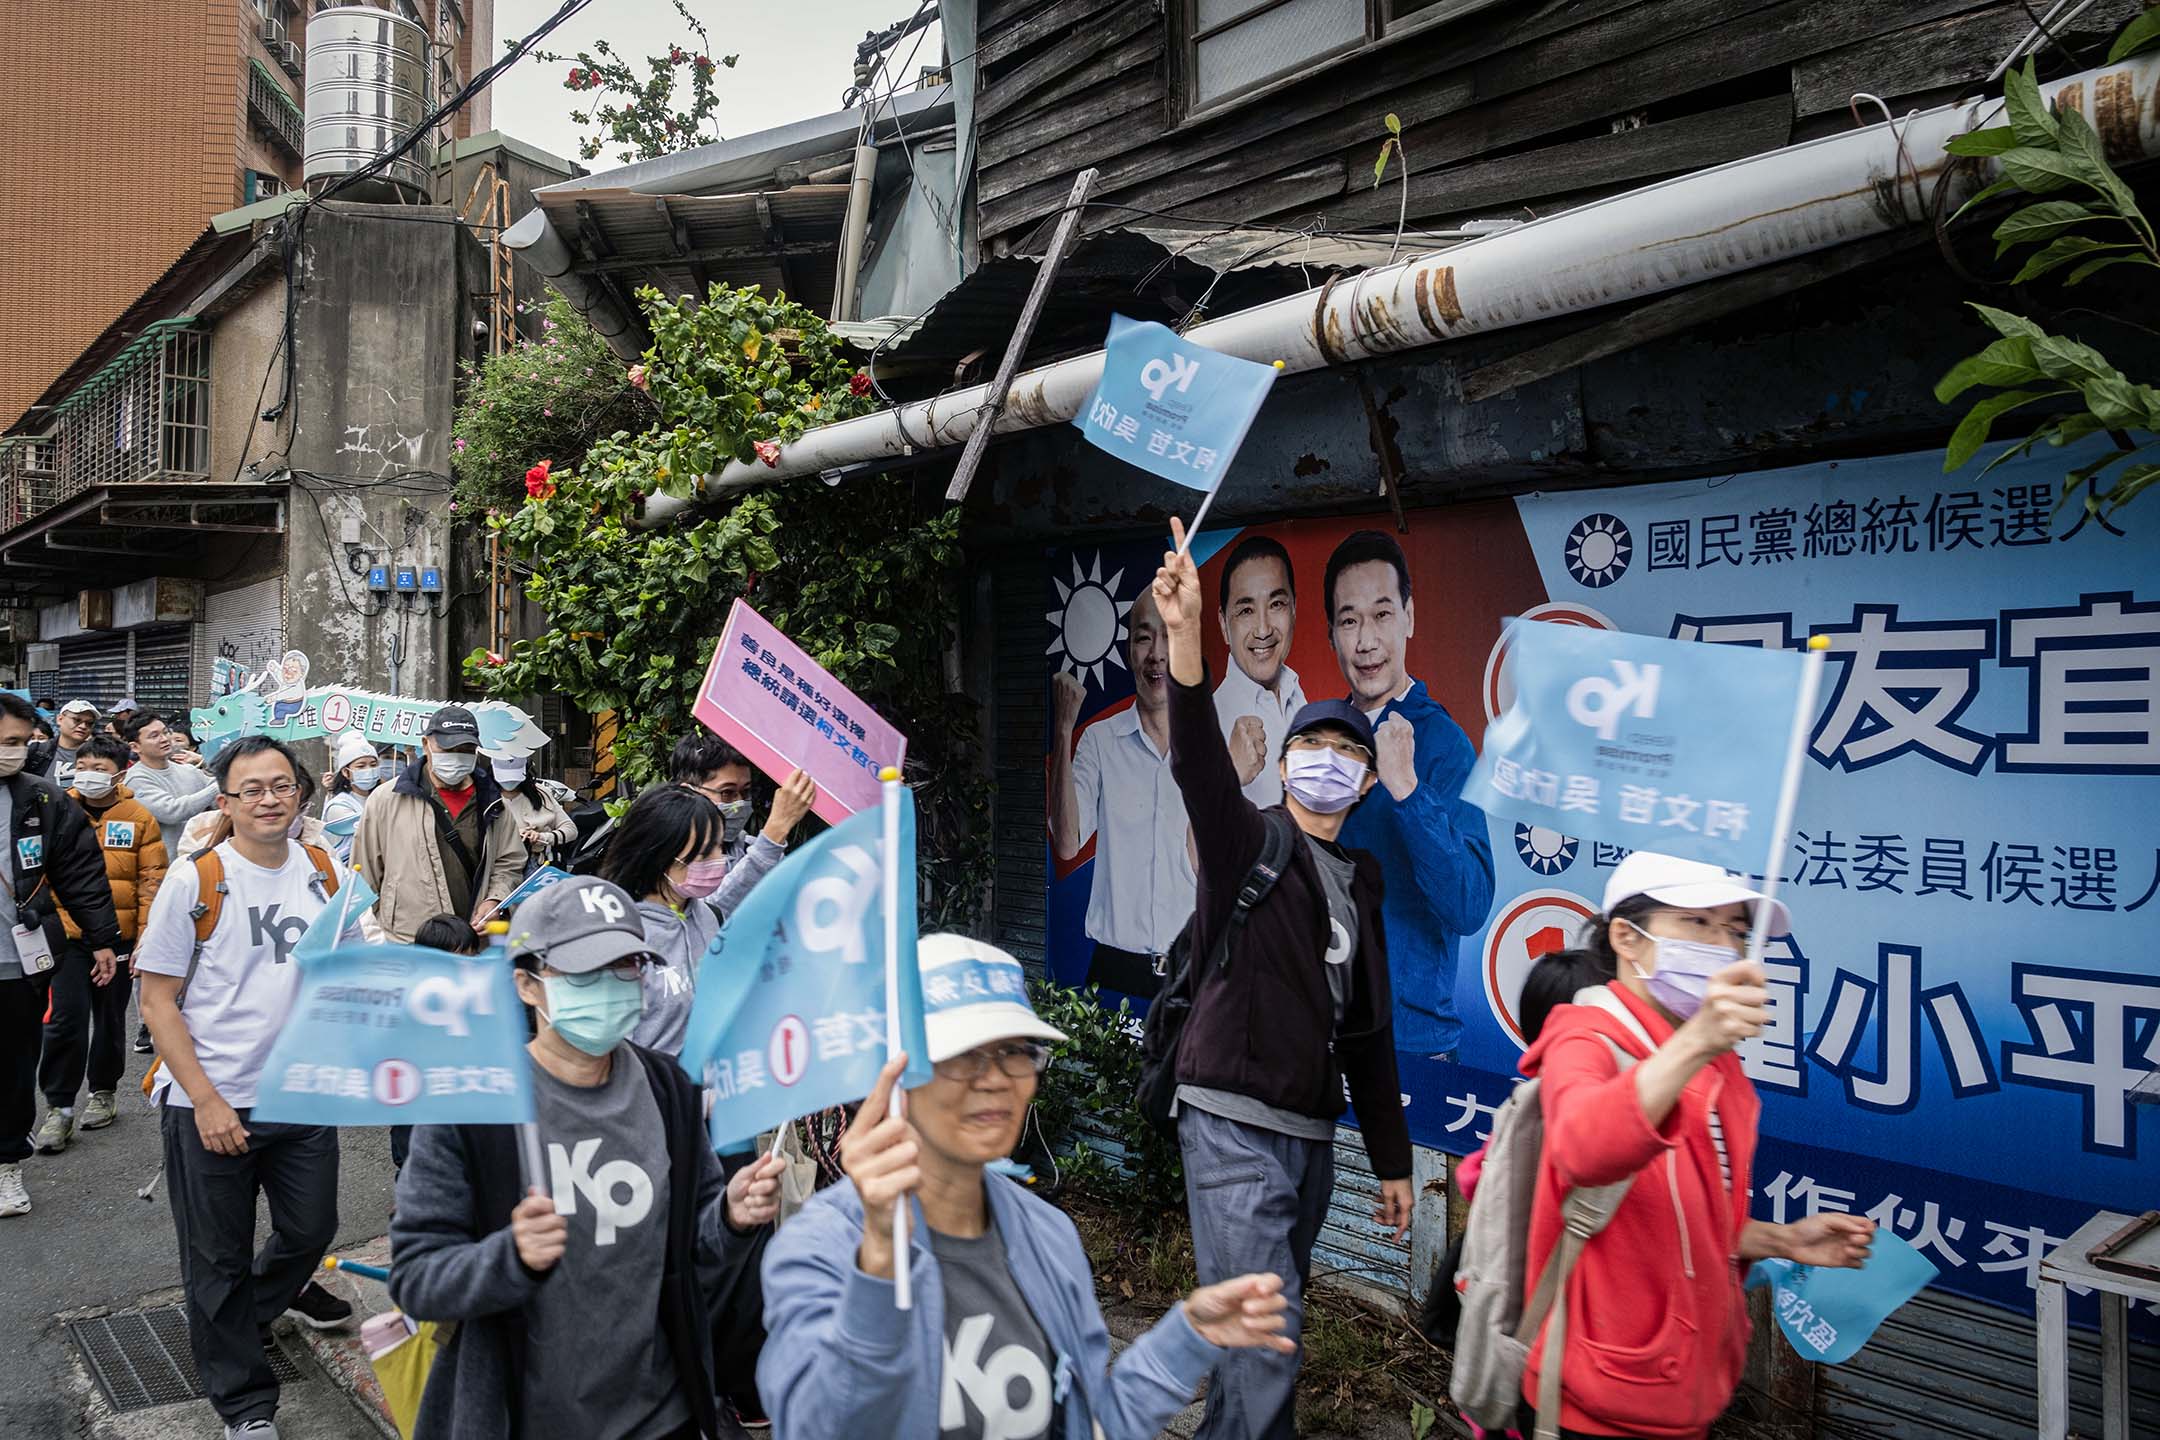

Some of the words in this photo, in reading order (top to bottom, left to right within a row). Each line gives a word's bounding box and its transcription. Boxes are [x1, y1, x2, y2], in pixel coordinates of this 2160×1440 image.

[1648, 477, 2127, 572] 國民黨總統候選人
[1669, 591, 2160, 777] 友宜
